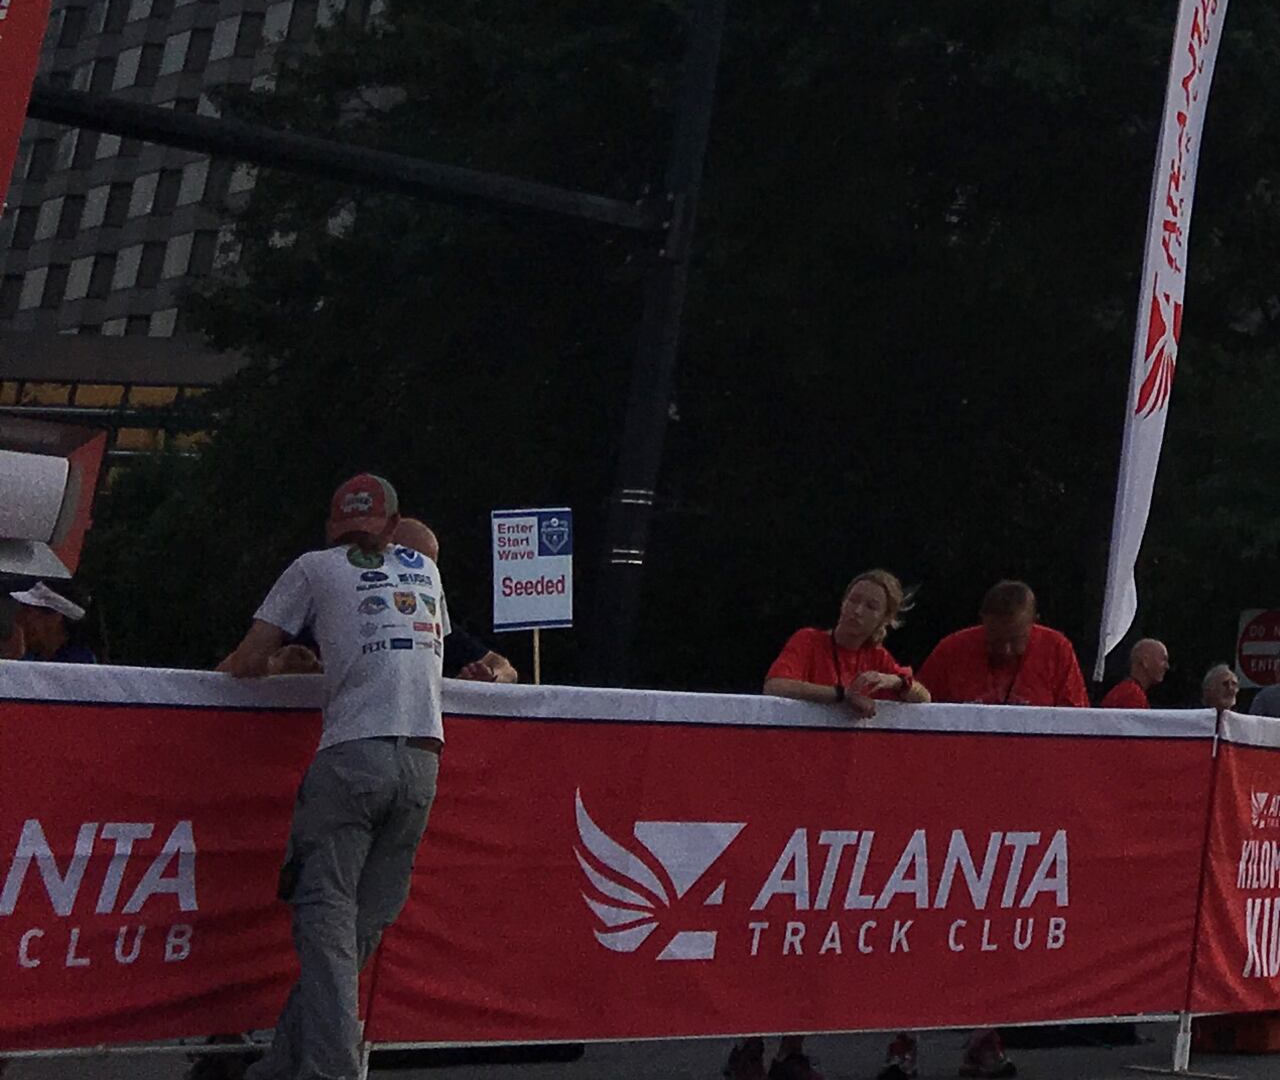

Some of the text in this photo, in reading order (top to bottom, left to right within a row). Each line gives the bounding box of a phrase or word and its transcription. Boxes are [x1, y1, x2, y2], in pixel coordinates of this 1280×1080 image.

[497, 523, 534, 534] Enter
[497, 536, 530, 548] Start
[497, 550, 535, 561] Wave
[502, 575, 566, 597] Seeded
[1249, 625, 1266, 638] DO
[750, 827, 1070, 911] ATLANTA
[748, 916, 1067, 956] TRACK CLUB
[19, 923, 193, 968] CLUB
